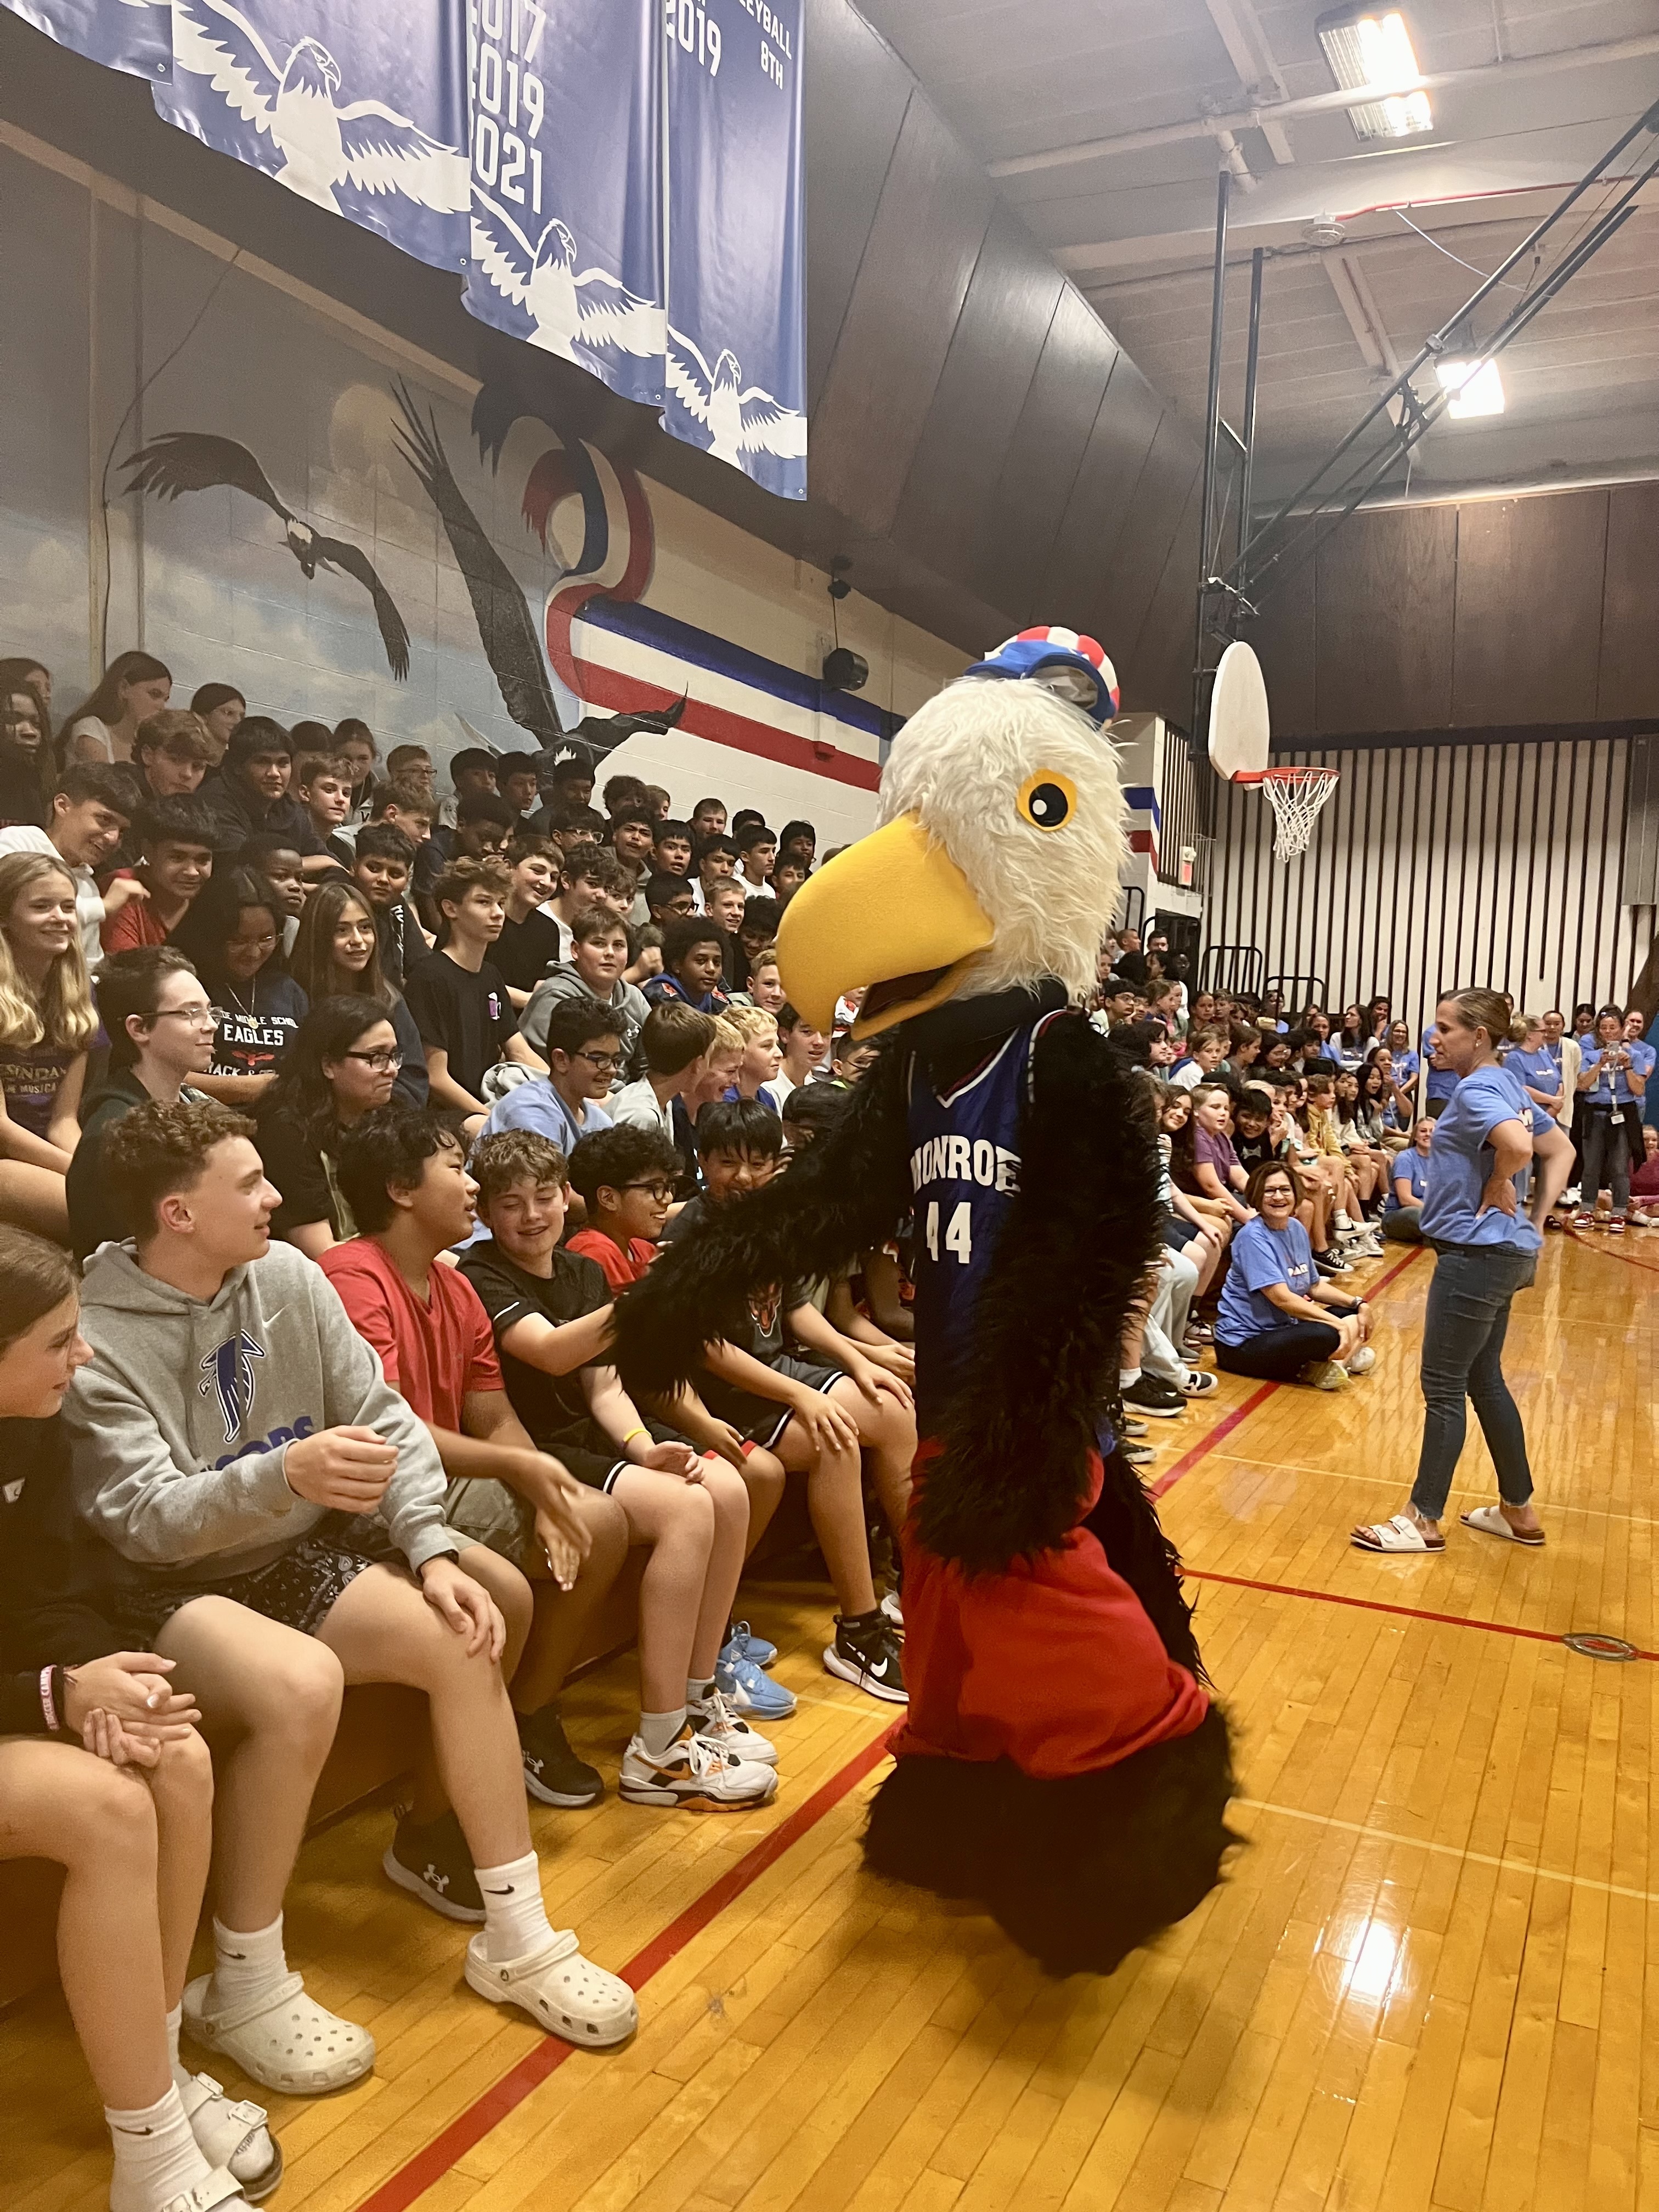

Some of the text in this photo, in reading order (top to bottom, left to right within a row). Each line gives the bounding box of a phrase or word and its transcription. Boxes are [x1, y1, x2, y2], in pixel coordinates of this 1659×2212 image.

[471, 0, 546, 64] 017
[761, 40, 783, 90] 8TH
[473, 110, 543, 215] 021
[224, 1024, 284, 1046] EAGLES
[910, 1135, 1022, 1198] MONROE
[926, 1201, 972, 1264] 44
